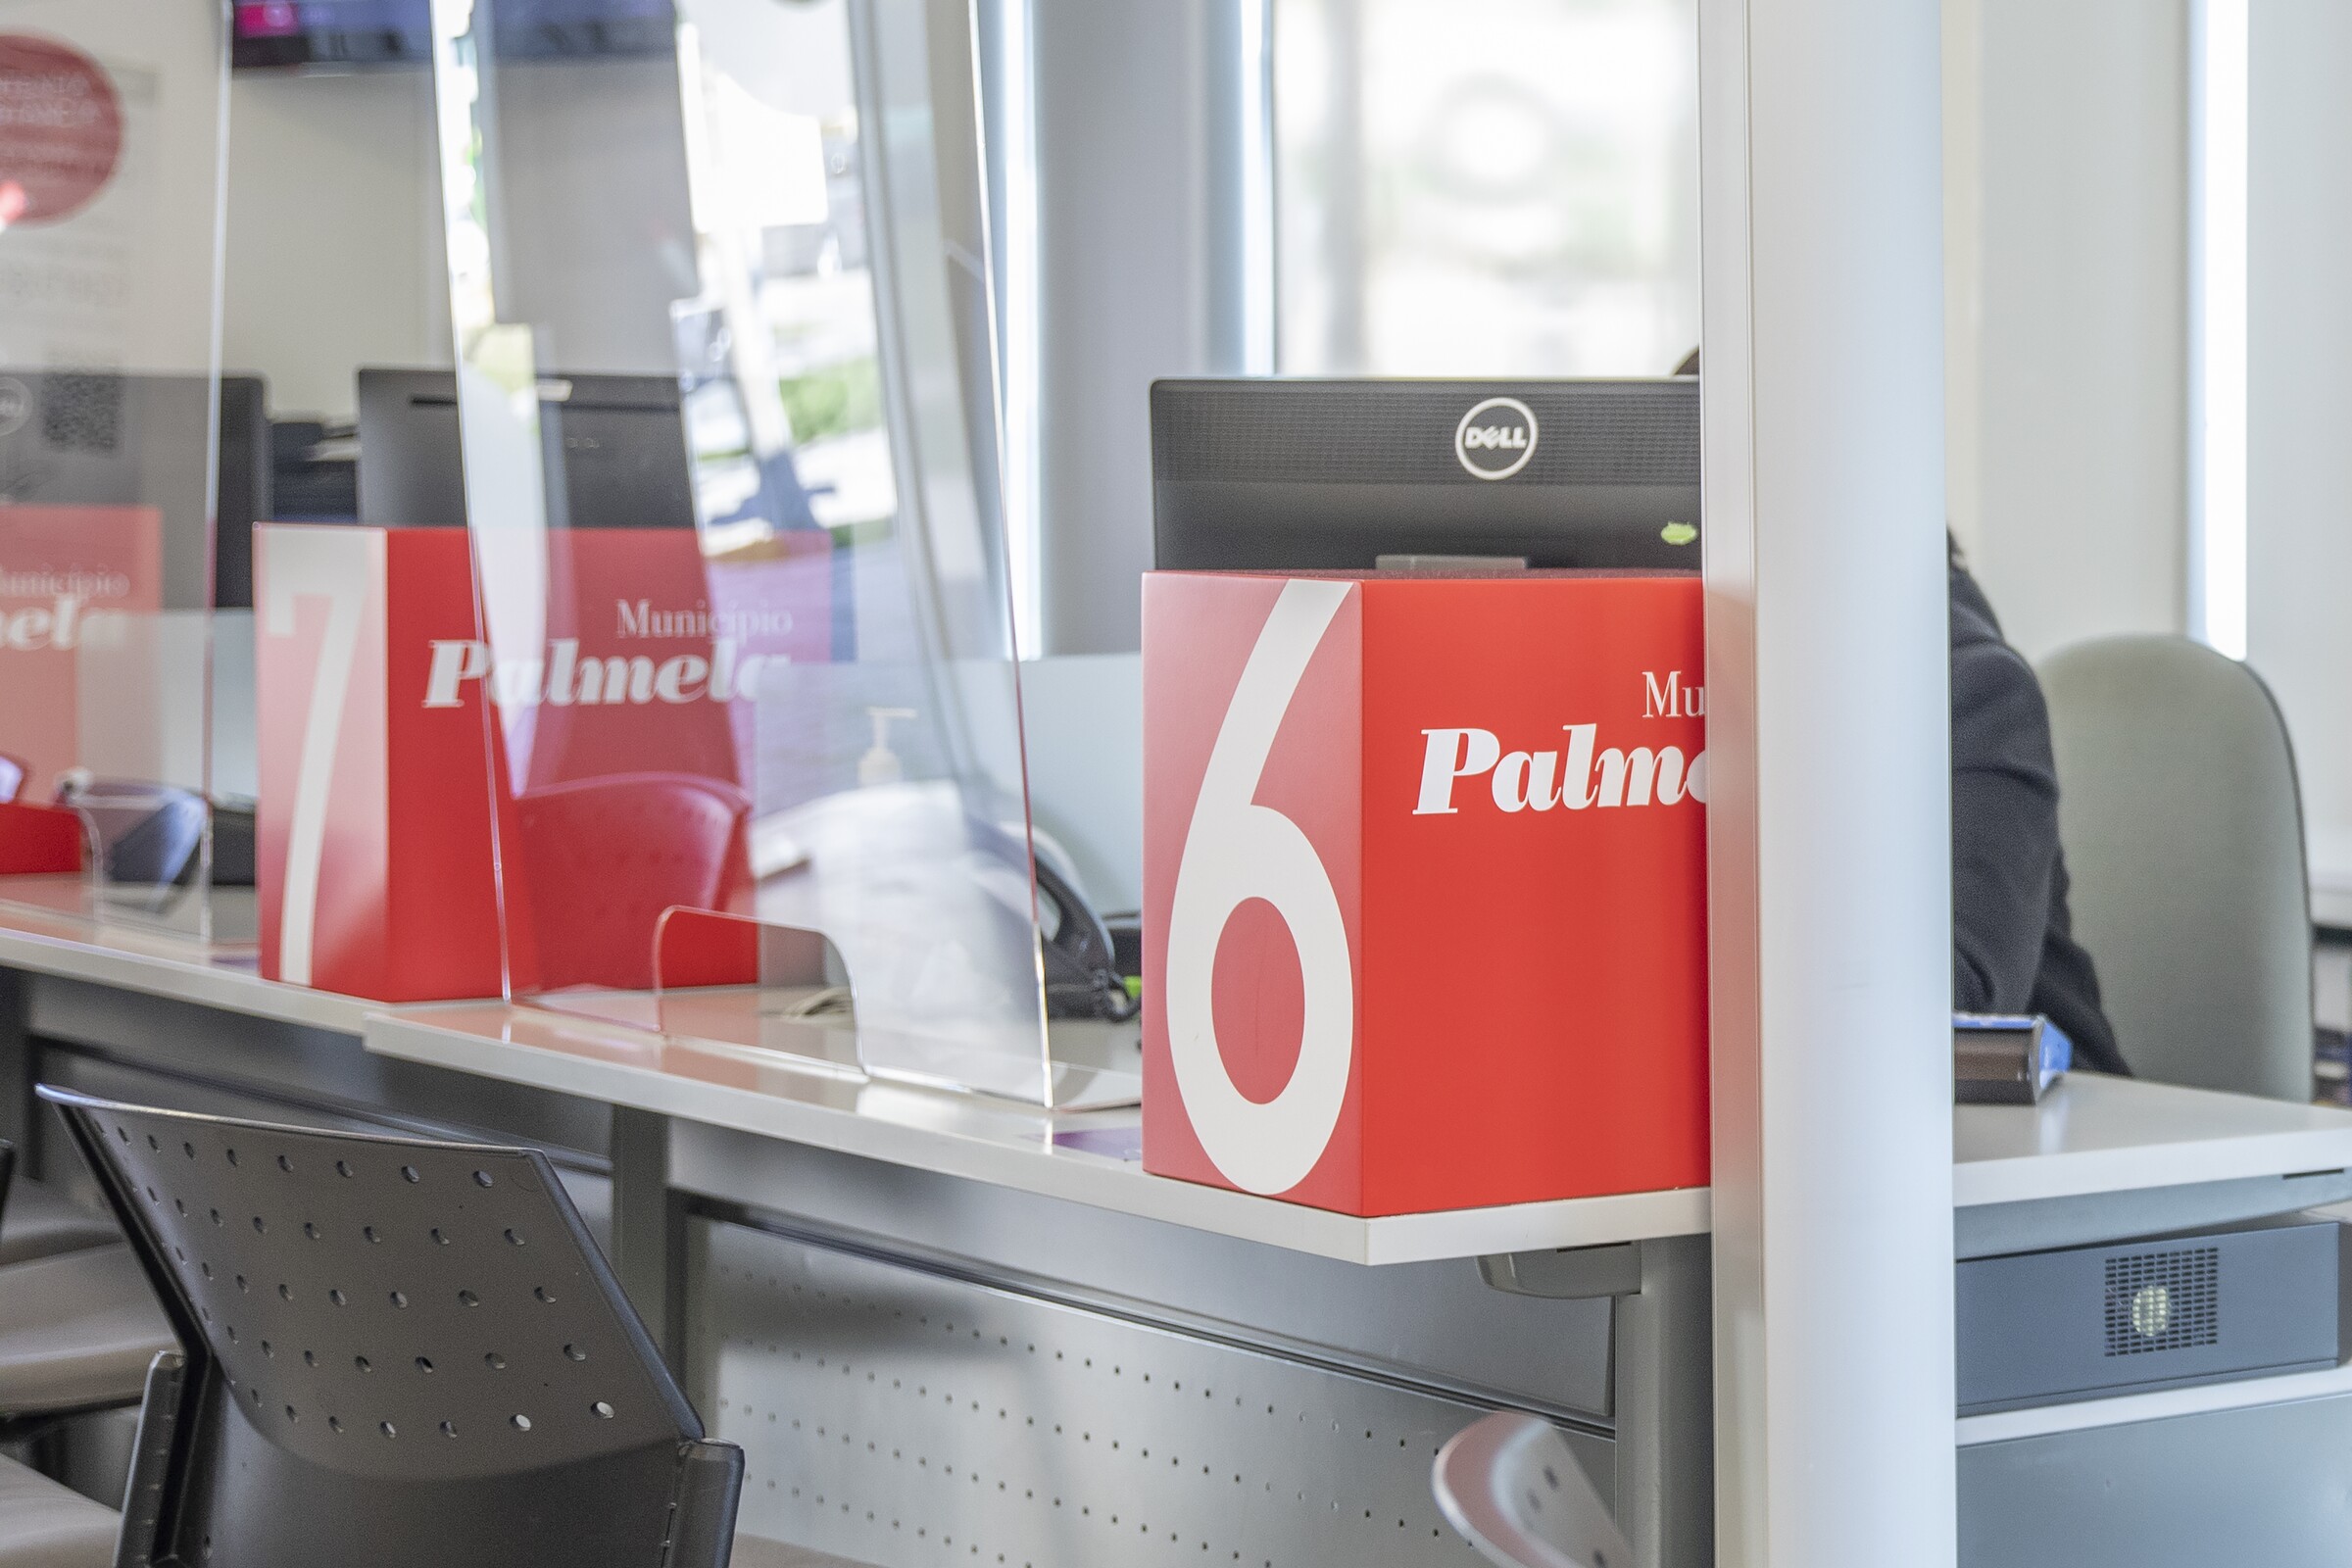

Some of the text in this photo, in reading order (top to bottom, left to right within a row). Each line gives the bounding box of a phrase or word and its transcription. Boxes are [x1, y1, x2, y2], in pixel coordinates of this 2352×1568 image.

[1464, 425, 1527, 450] DELL
[267, 528, 368, 987] 7
[1166, 578, 1354, 1196] 6
[1412, 723, 1705, 815] Palm
